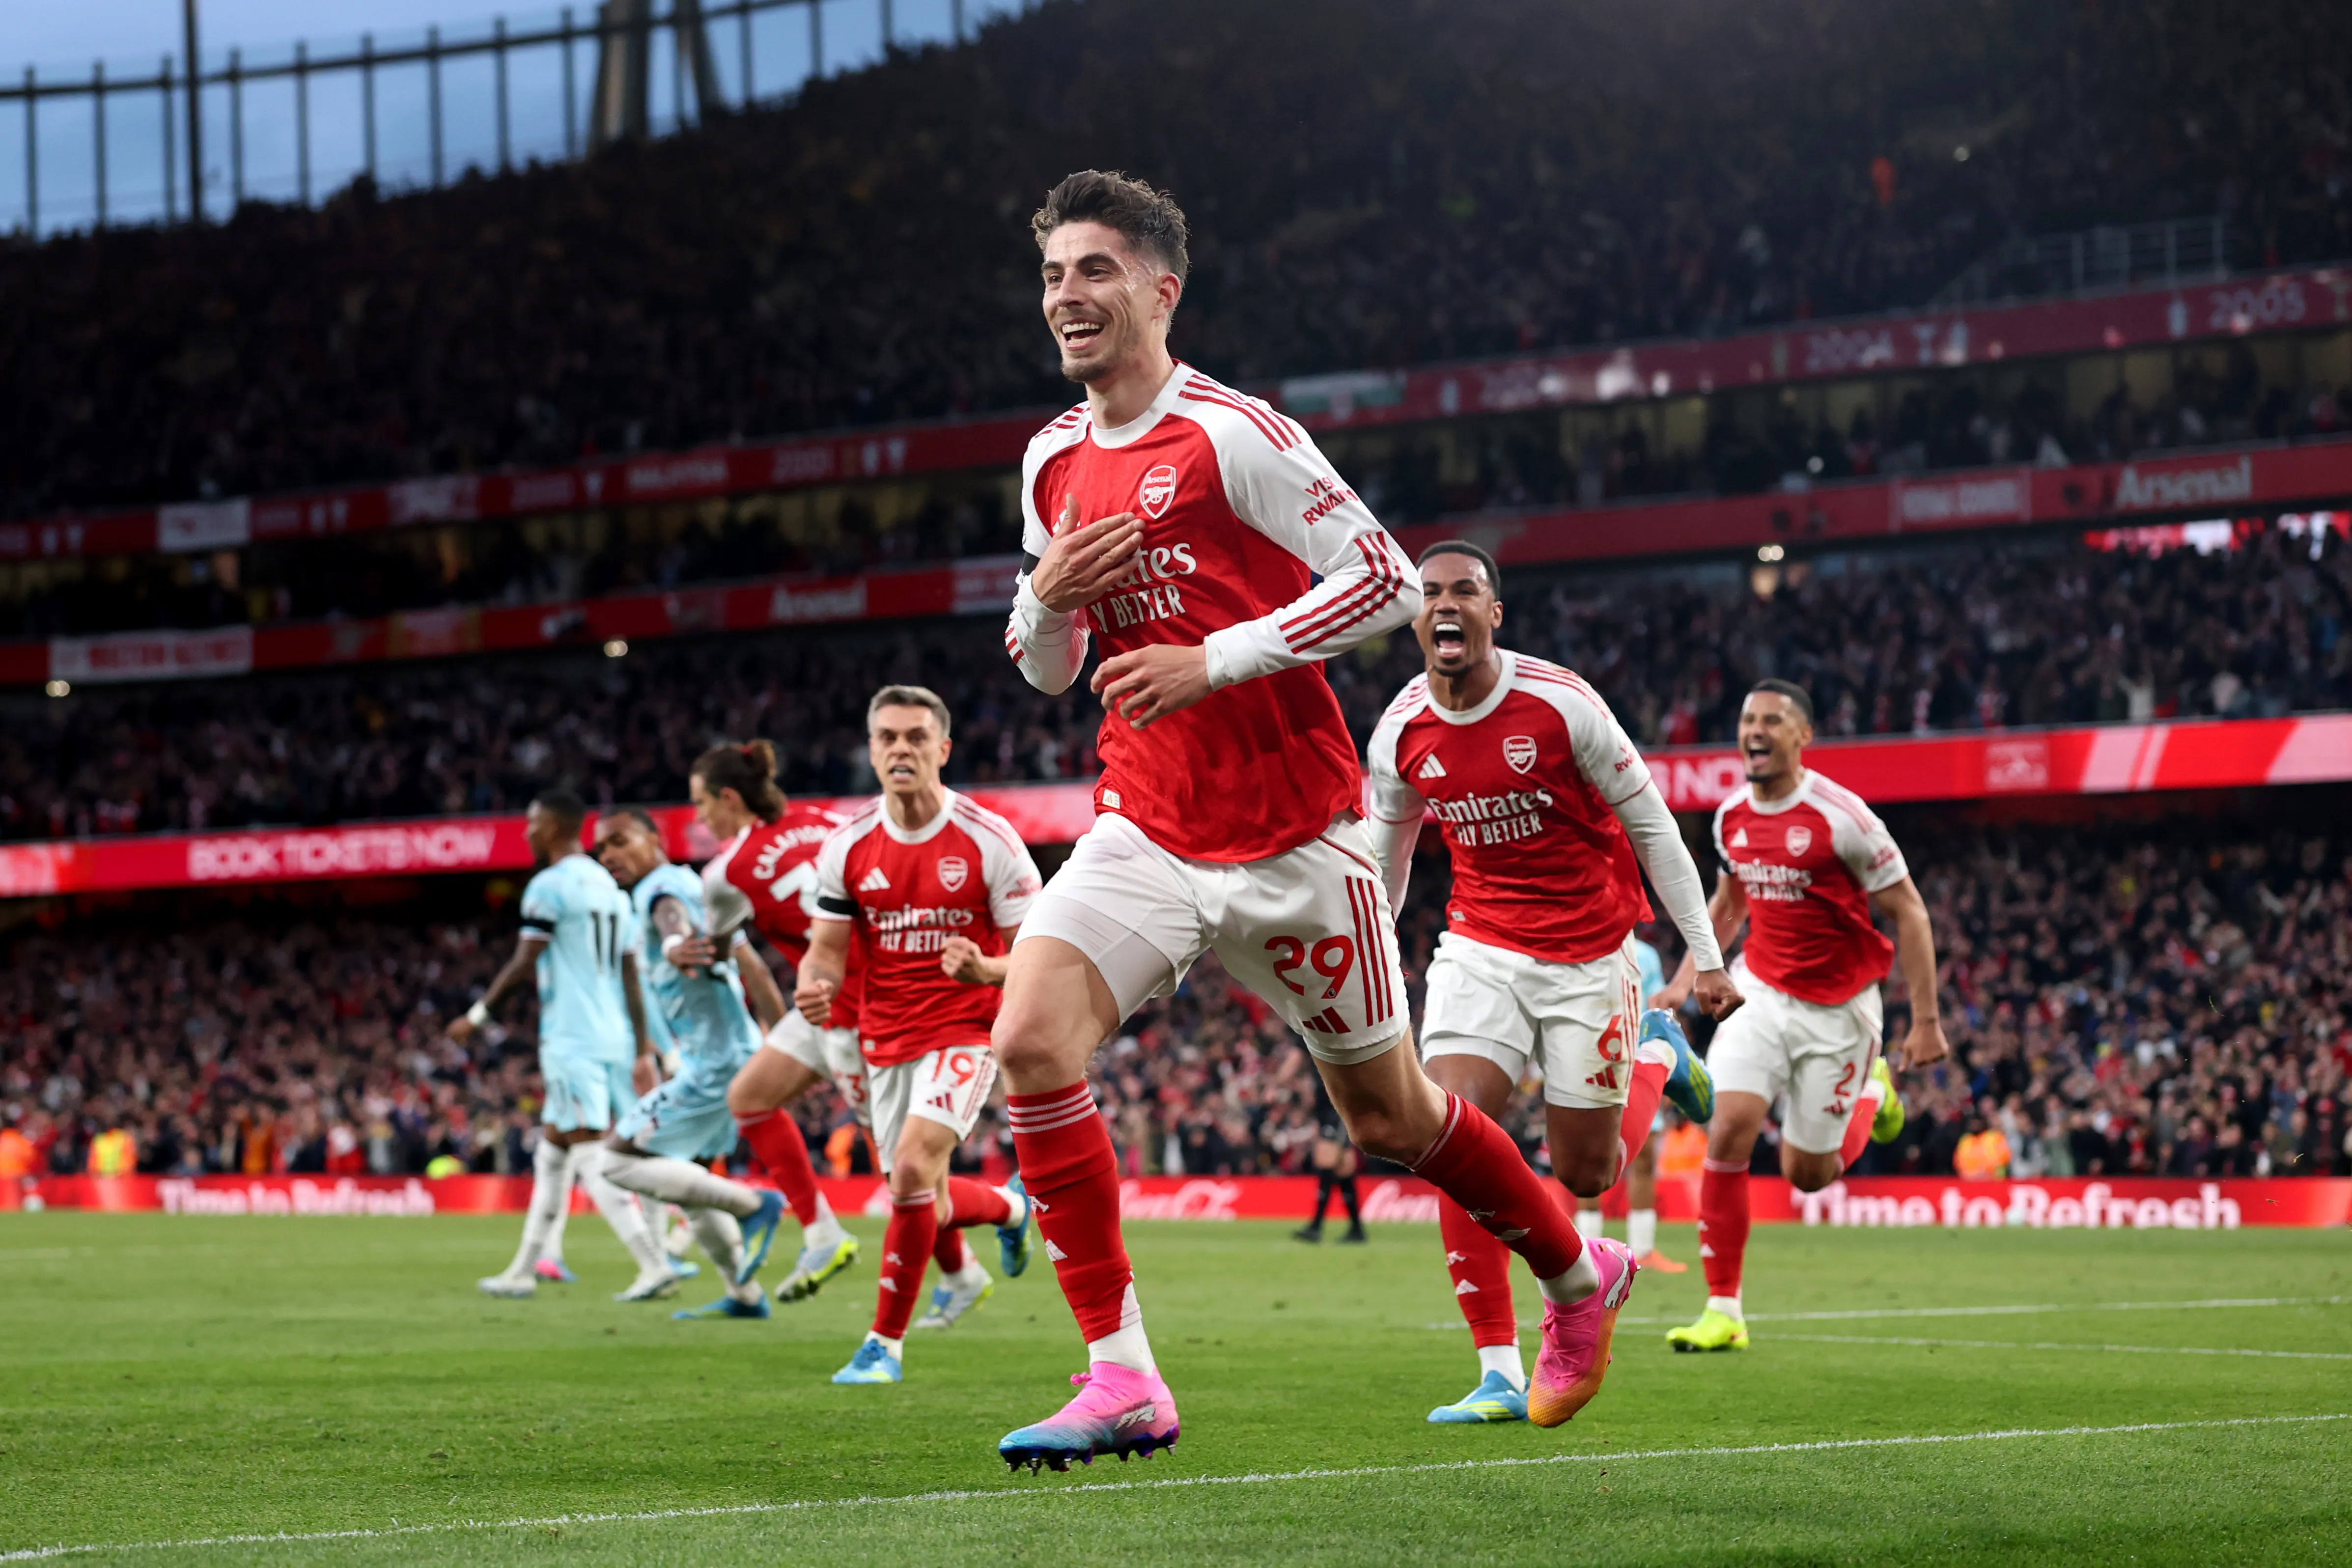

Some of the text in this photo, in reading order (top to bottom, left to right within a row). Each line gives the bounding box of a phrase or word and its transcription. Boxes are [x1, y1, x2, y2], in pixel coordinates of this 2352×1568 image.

[2114, 455, 2253, 509] Arsenal
[1111, 584, 1186, 629] BETTER
[1427, 787, 1553, 823] Emirates
[189, 837, 279, 879] BOOK
[412, 823, 496, 868] NOW
[1481, 812, 1543, 845] BETTER
[864, 903, 974, 930] Emirates
[590, 911, 617, 972] 11
[1264, 935, 1354, 999] 29
[1598, 1014, 1622, 1063] 6
[931, 1049, 975, 1089] 19
[1834, 1062, 1855, 1097] 2
[156, 1178, 247, 1216] Time
[1791, 1180, 2241, 1228] Time to Refresh
